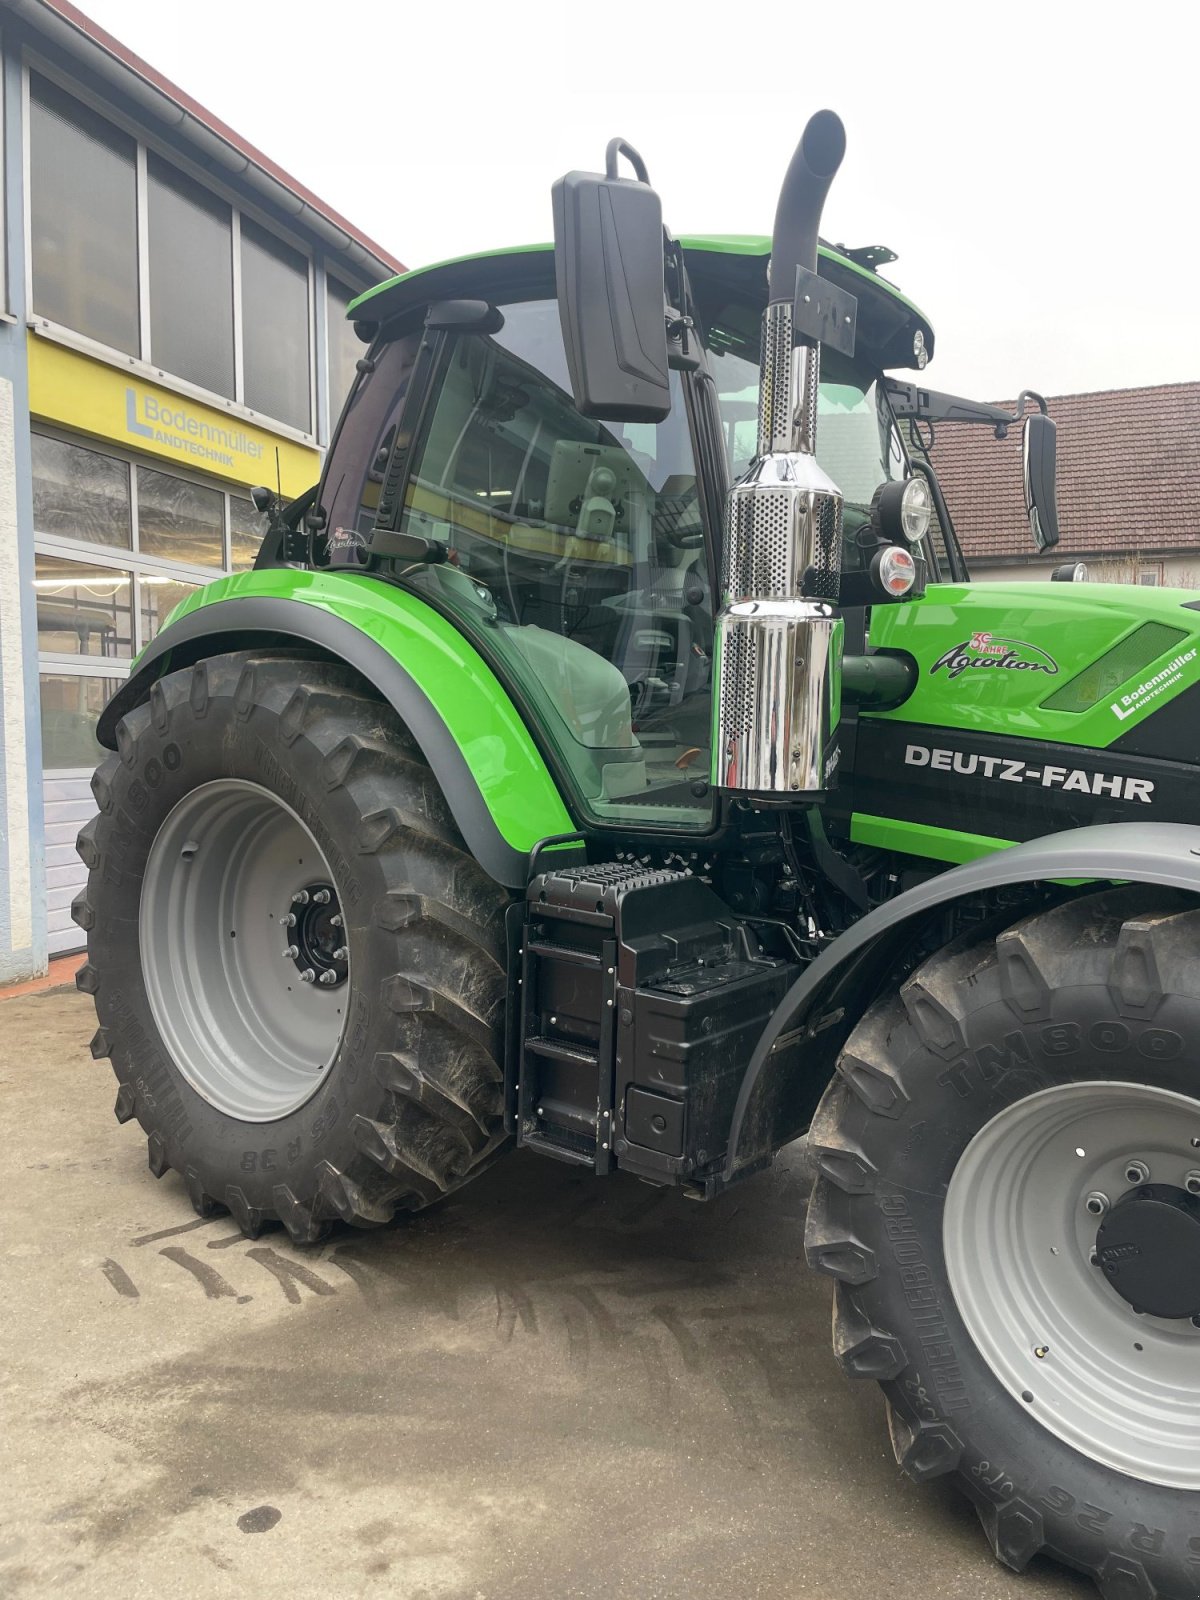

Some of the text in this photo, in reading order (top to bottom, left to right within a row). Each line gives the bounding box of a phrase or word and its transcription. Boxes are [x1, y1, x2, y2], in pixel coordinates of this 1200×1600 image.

[143, 395, 264, 459] Bodenmüller
[929, 638, 1059, 679] Agrotron
[978, 644, 1008, 655] JAHRE
[1121, 648, 1198, 706] Bodenmüller
[904, 744, 1155, 804] DEUTZ-FAHR
[881, 1194, 970, 1418] TRELLEBORG
